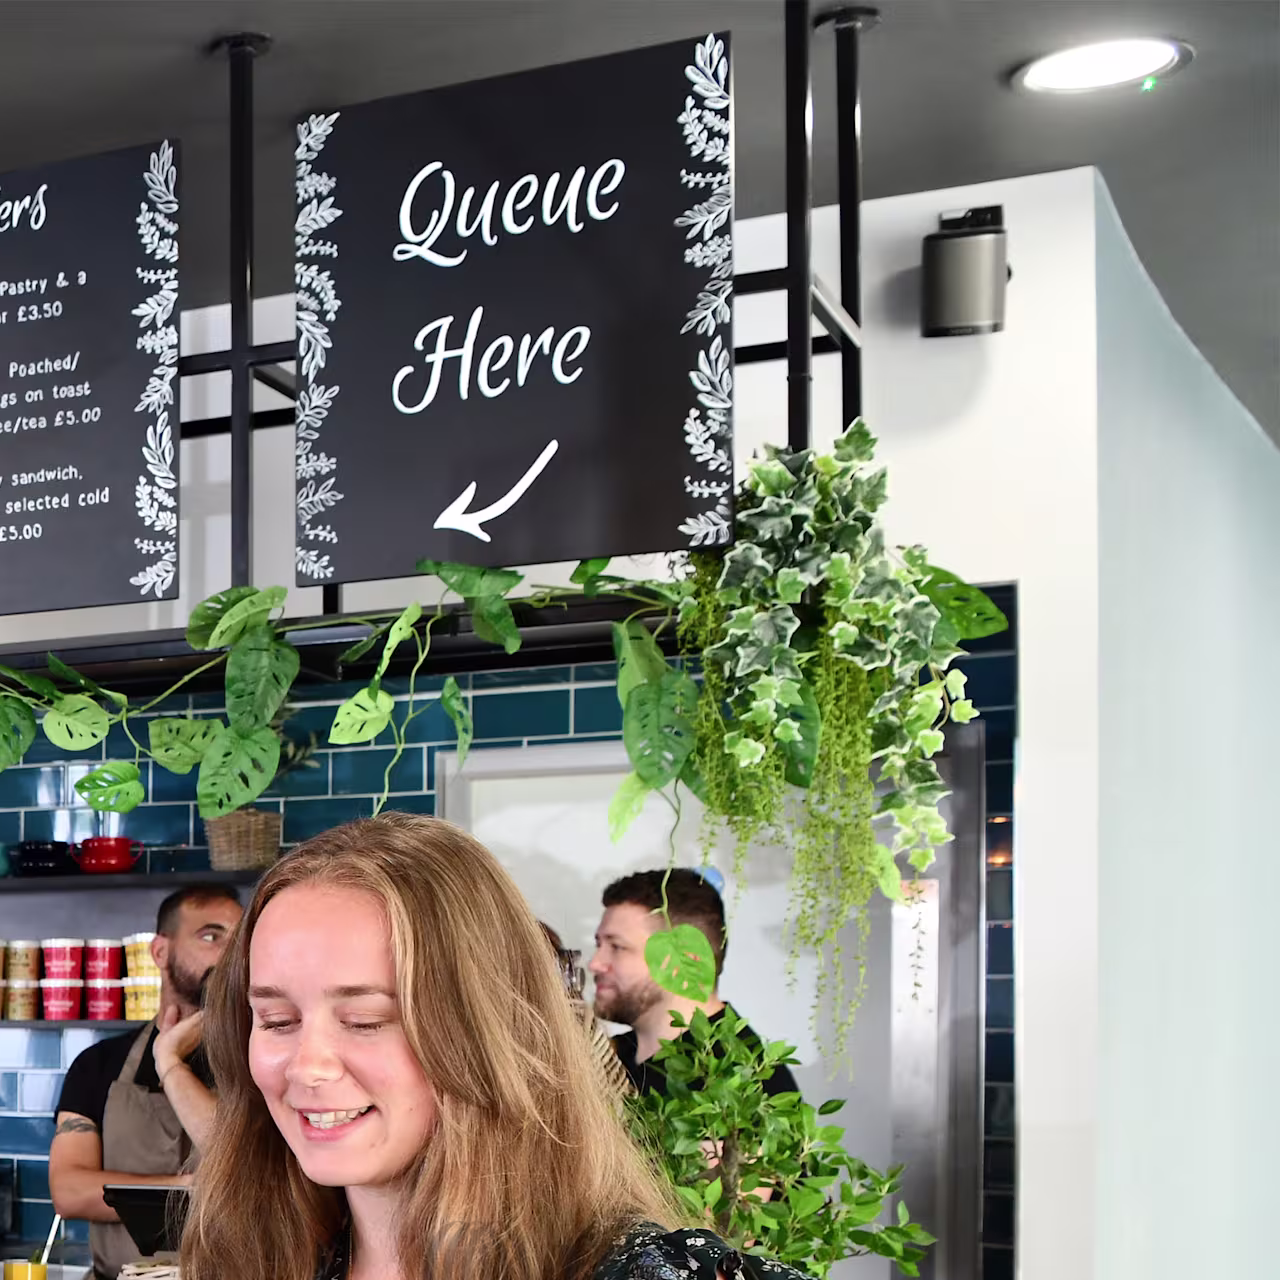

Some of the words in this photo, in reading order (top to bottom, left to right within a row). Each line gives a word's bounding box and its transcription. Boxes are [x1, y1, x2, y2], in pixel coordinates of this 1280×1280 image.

[393, 159, 625, 267] Queue
[0, 277, 47, 296] Pastry
[56, 272, 69, 287] &
[78, 271, 87, 285] a
[18, 301, 63, 322] £3.50
[9, 351, 81, 379] Poached/
[392, 306, 591, 413] Here
[25, 389, 43, 402] on
[53, 382, 90, 399] toast
[54, 407, 101, 428] £5.00
[11, 465, 82, 486] sandwich,
[5, 494, 69, 514] selected
[78, 487, 109, 507] cold
